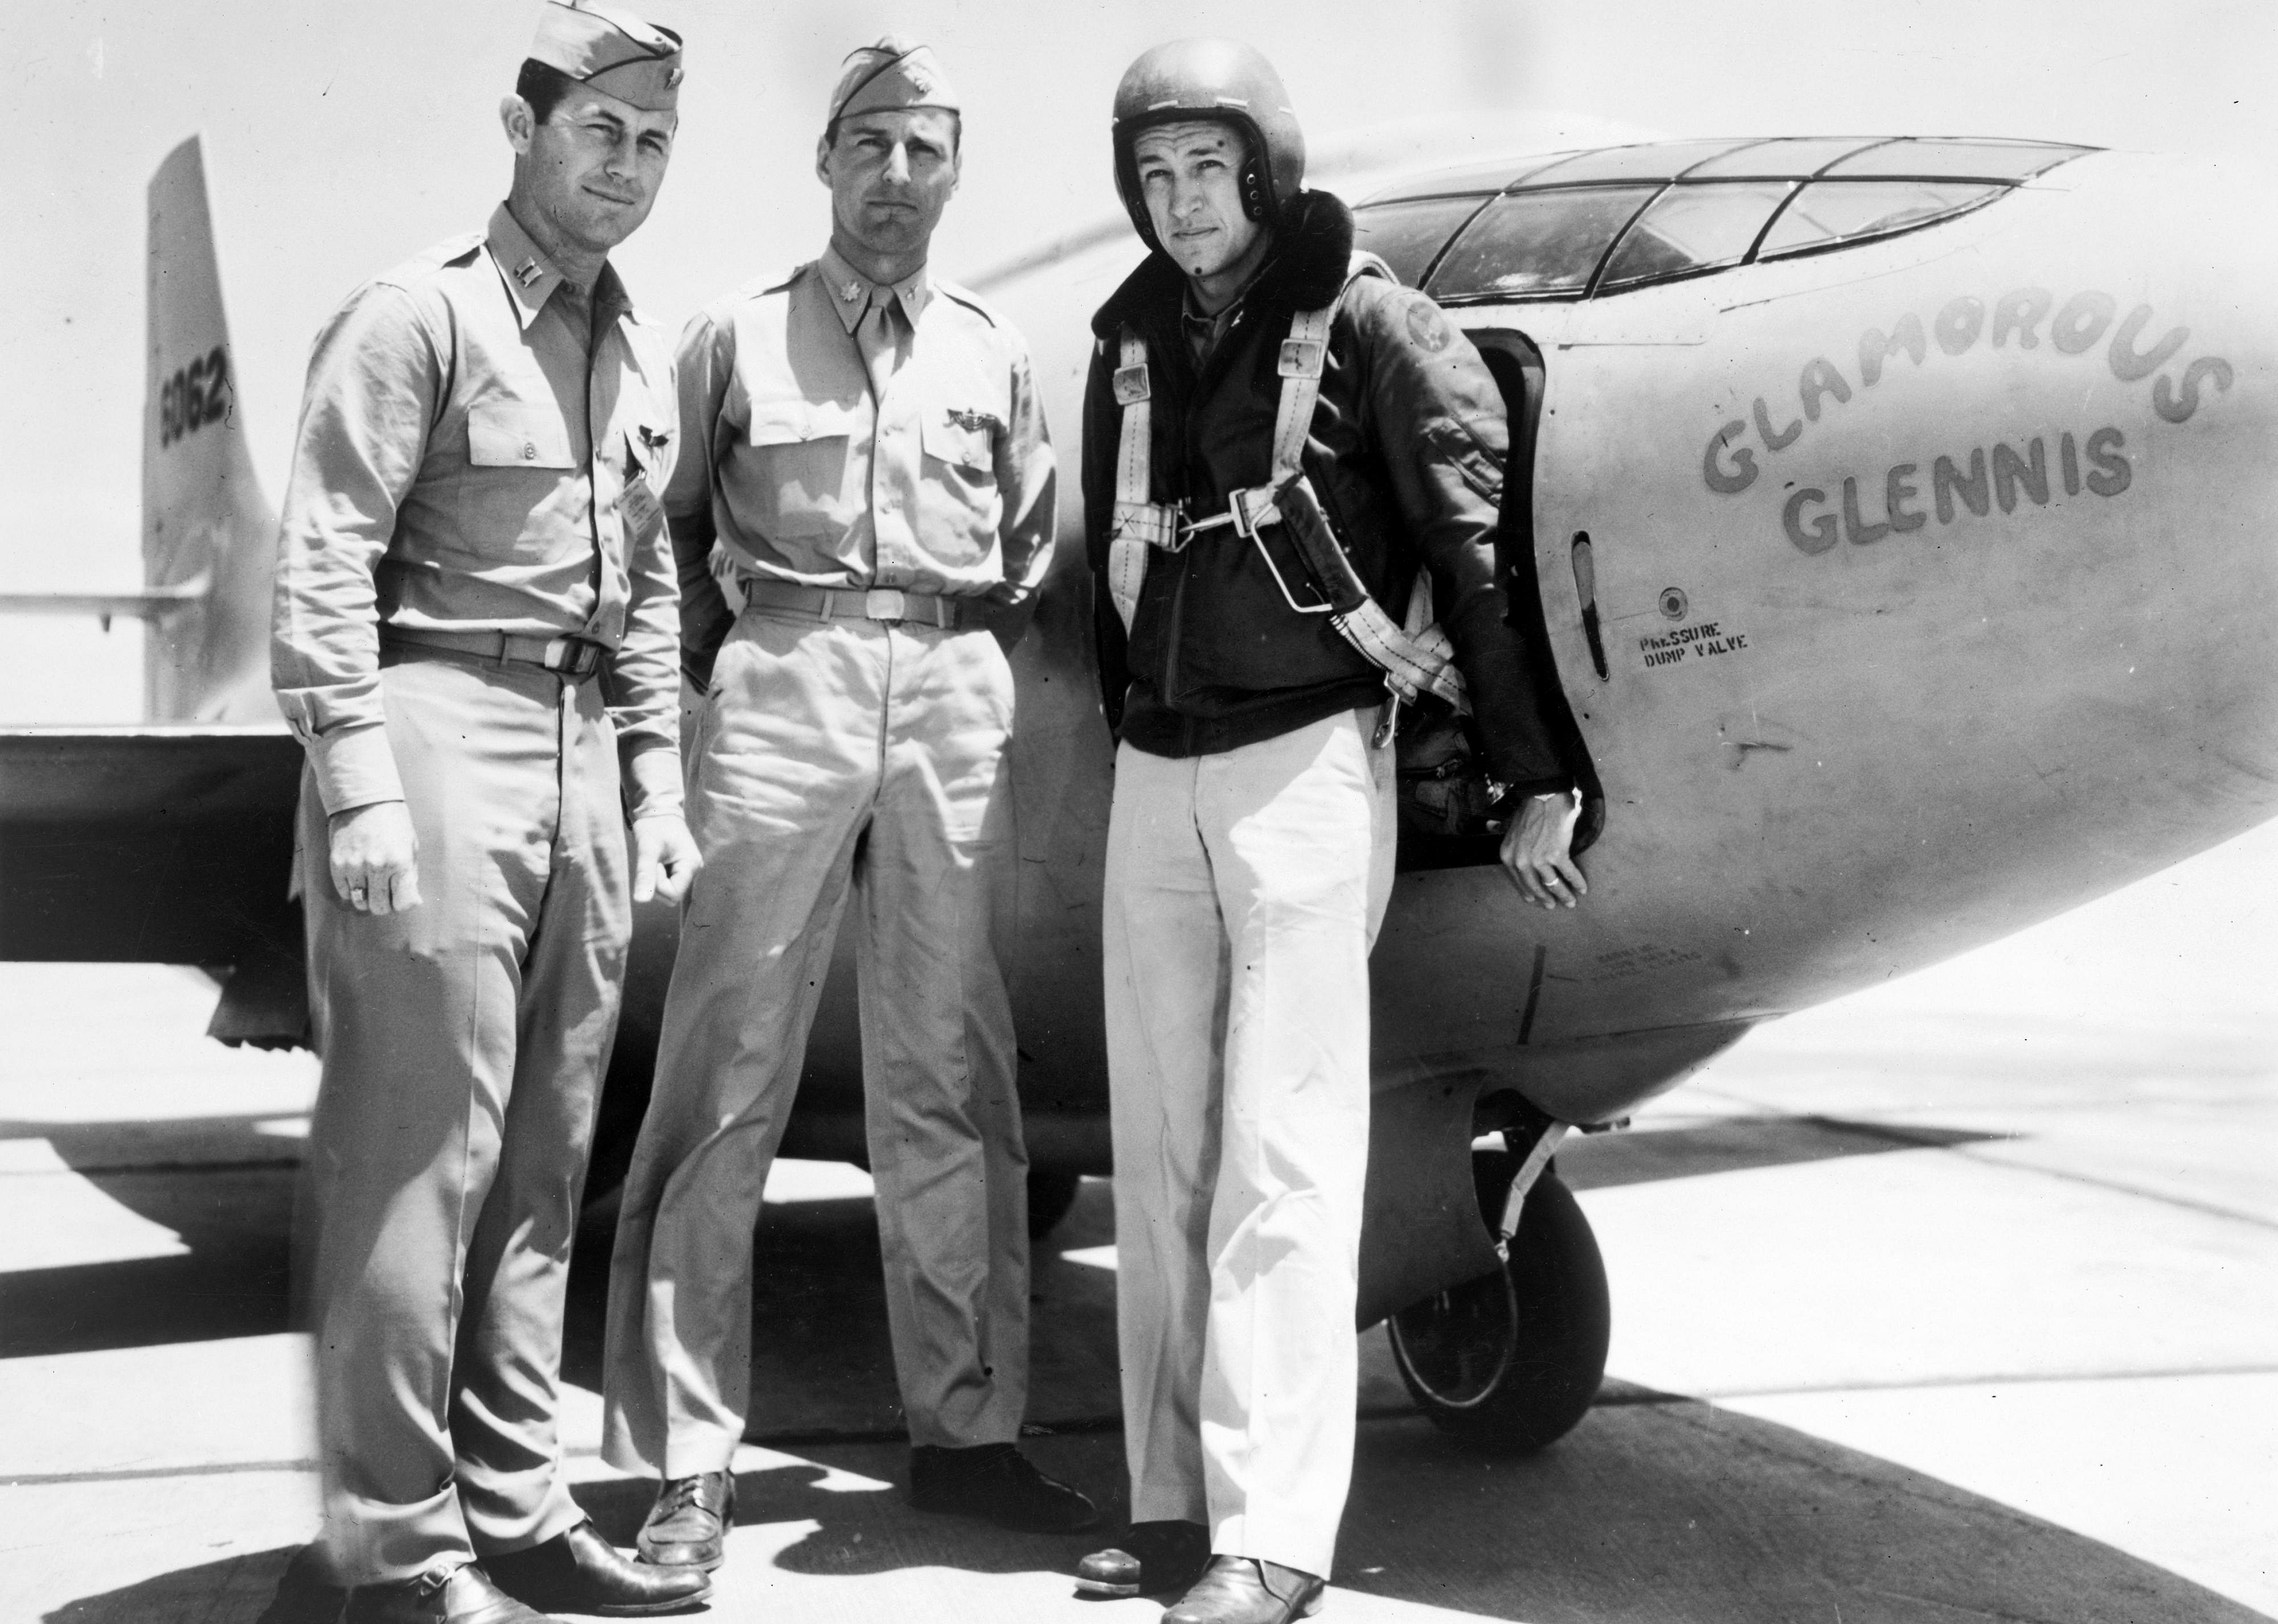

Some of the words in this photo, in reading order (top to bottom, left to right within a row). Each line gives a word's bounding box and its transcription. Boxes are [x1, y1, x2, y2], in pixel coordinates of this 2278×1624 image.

[1703, 286, 2234, 494] GLAMOROUS
[1783, 427, 2132, 555] GLENNIS
[1640, 622, 1722, 651] PRESSURE
[1644, 647, 1686, 668] DUMP
[1694, 634, 1748, 657] VALVE
